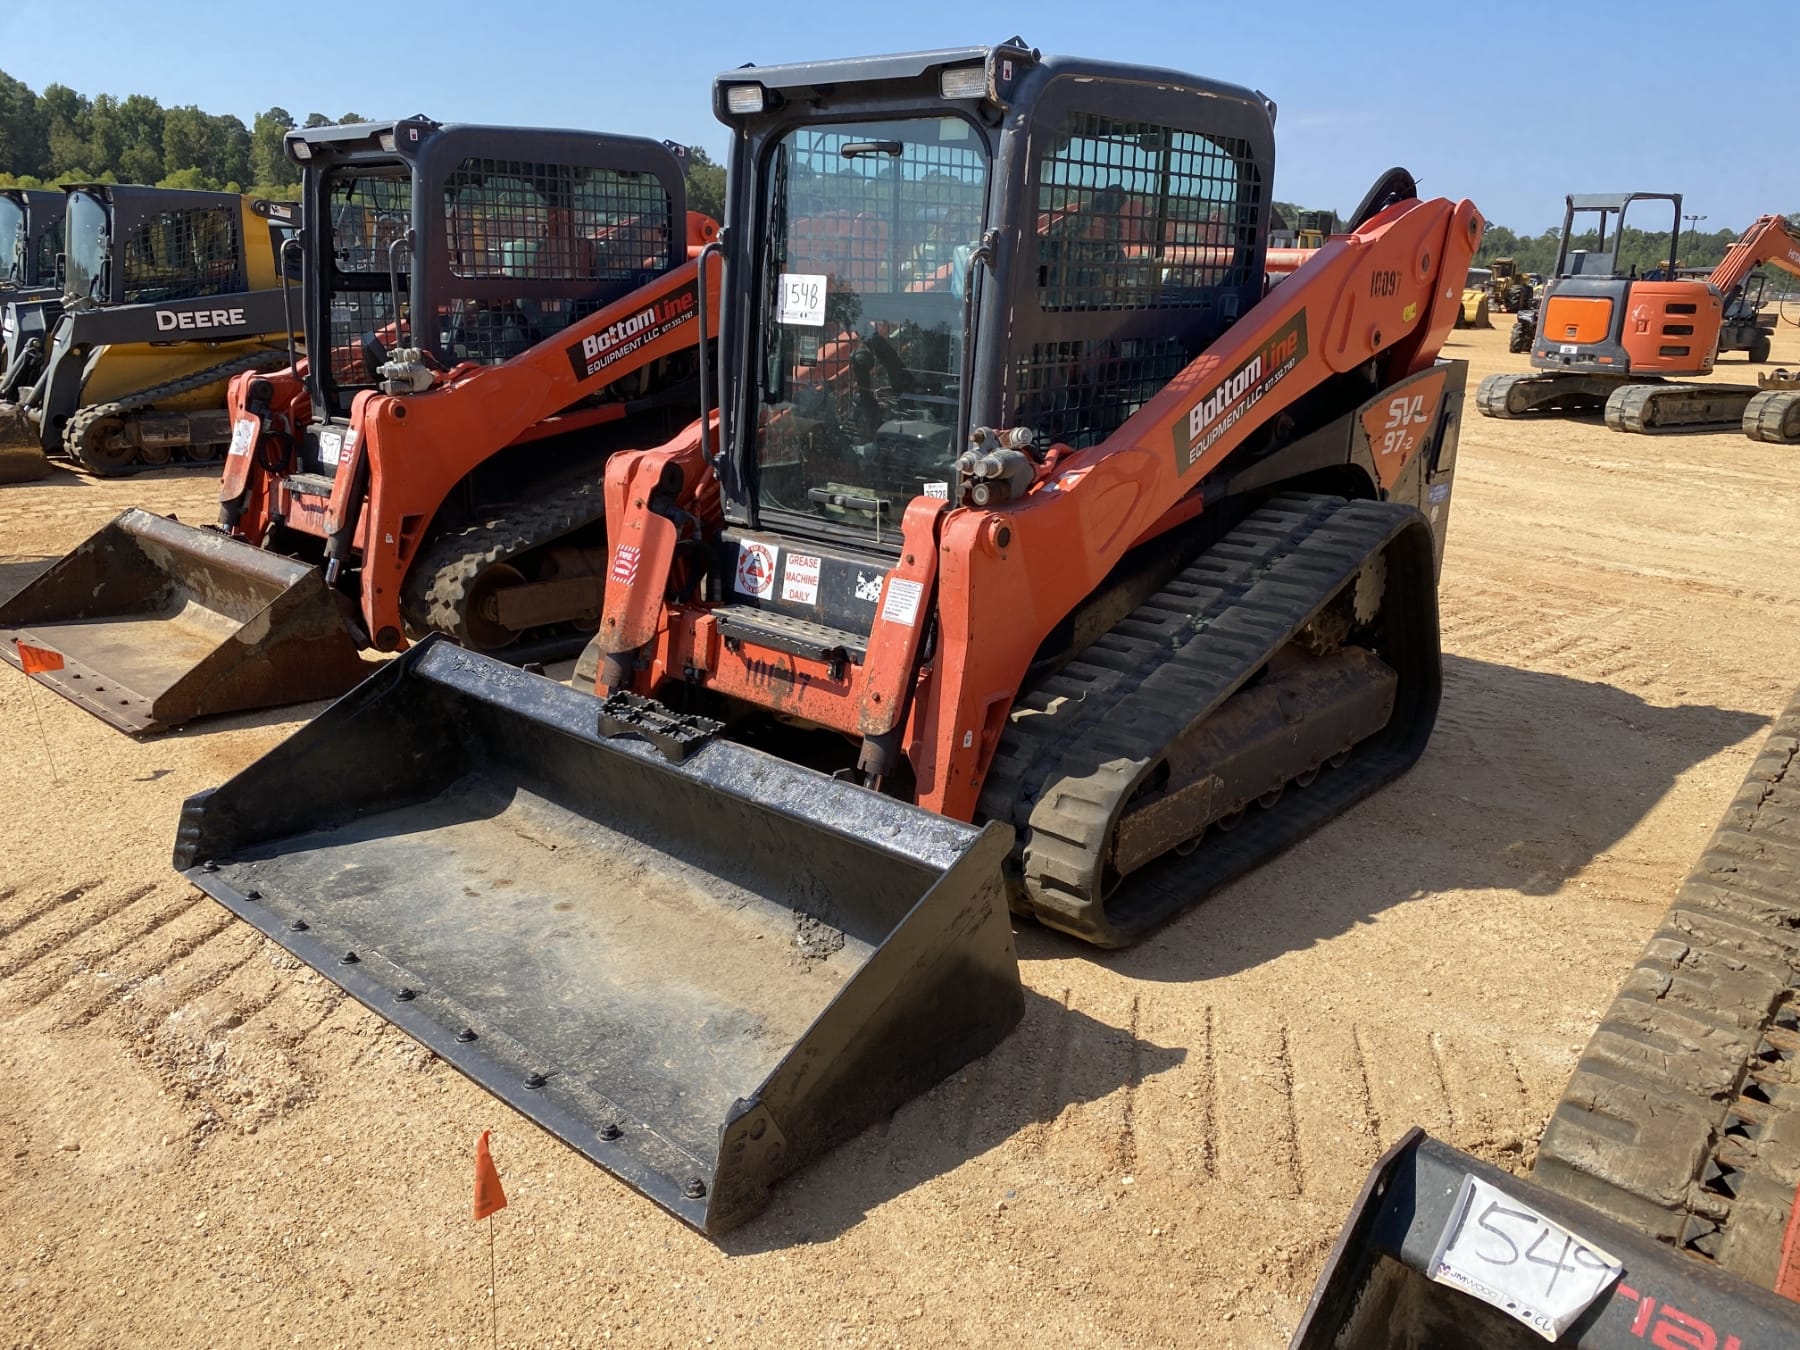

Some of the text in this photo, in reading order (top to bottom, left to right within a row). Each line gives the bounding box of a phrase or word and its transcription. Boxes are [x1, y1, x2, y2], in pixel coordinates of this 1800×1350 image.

[784, 282, 818, 310] 1548
[155, 308, 247, 331] DEERE
[586, 338, 642, 376] EQUIPMENT
[643, 328, 660, 344] LLC
[1188, 402, 1246, 465] EQUIPMENT
[1246, 385, 1263, 410] LLC
[1384, 395, 1428, 429] SVL
[788, 555, 819, 569] GREASE
[785, 571, 818, 587] MACHINE
[789, 588, 810, 602] DAILY
[1447, 1183, 1611, 1298] 1549
